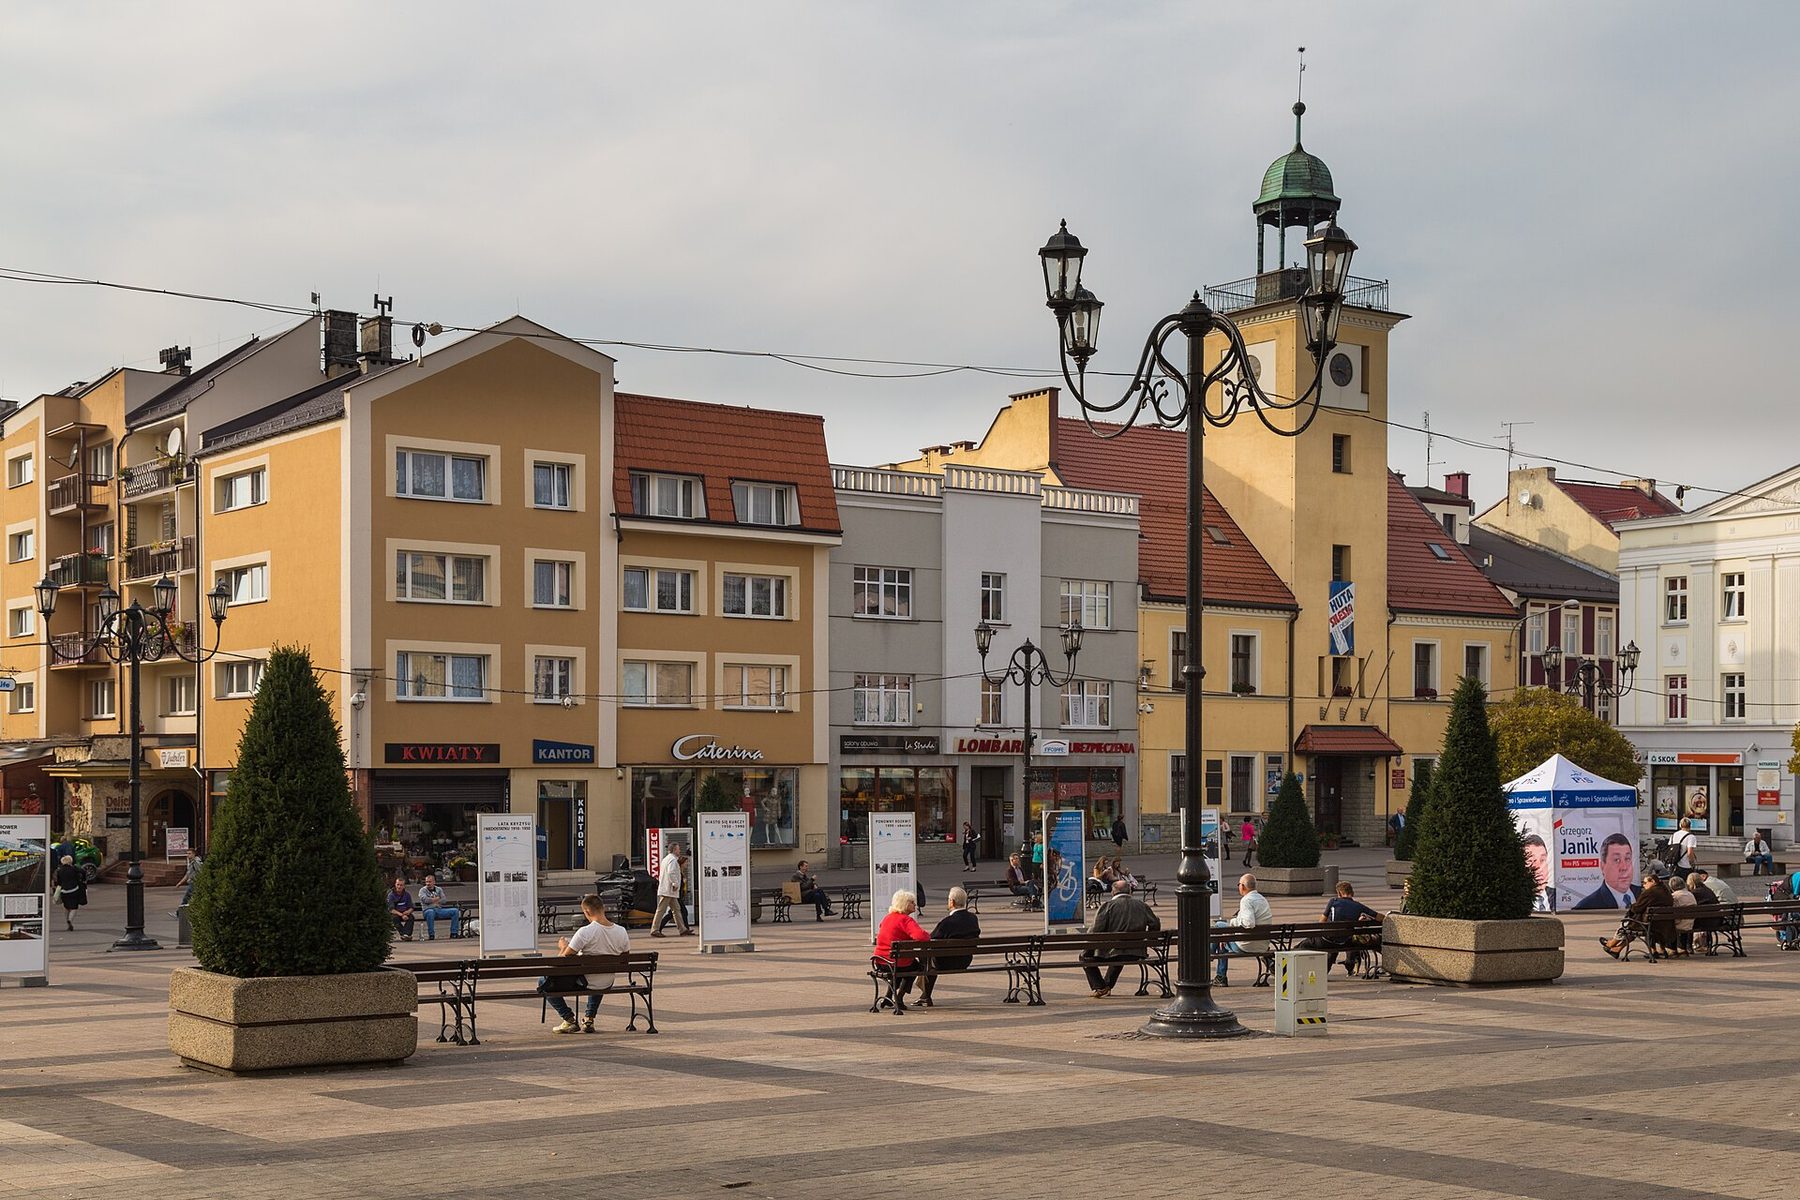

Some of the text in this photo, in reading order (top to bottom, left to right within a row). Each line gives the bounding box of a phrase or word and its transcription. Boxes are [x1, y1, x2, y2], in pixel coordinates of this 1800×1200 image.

[1330, 588, 1354, 613] HUTA
[402, 746, 485, 760] KWIATY
[672, 734, 764, 760] Caterina
[957, 739, 1024, 753] LOMBAR
[538, 749, 590, 759] KANTOR
[1657, 755, 1676, 763] SKOK
[1559, 826, 1592, 837] Grzegorz
[1560, 837, 1599, 855] Janik
[650, 832, 659, 878] YWIEC
